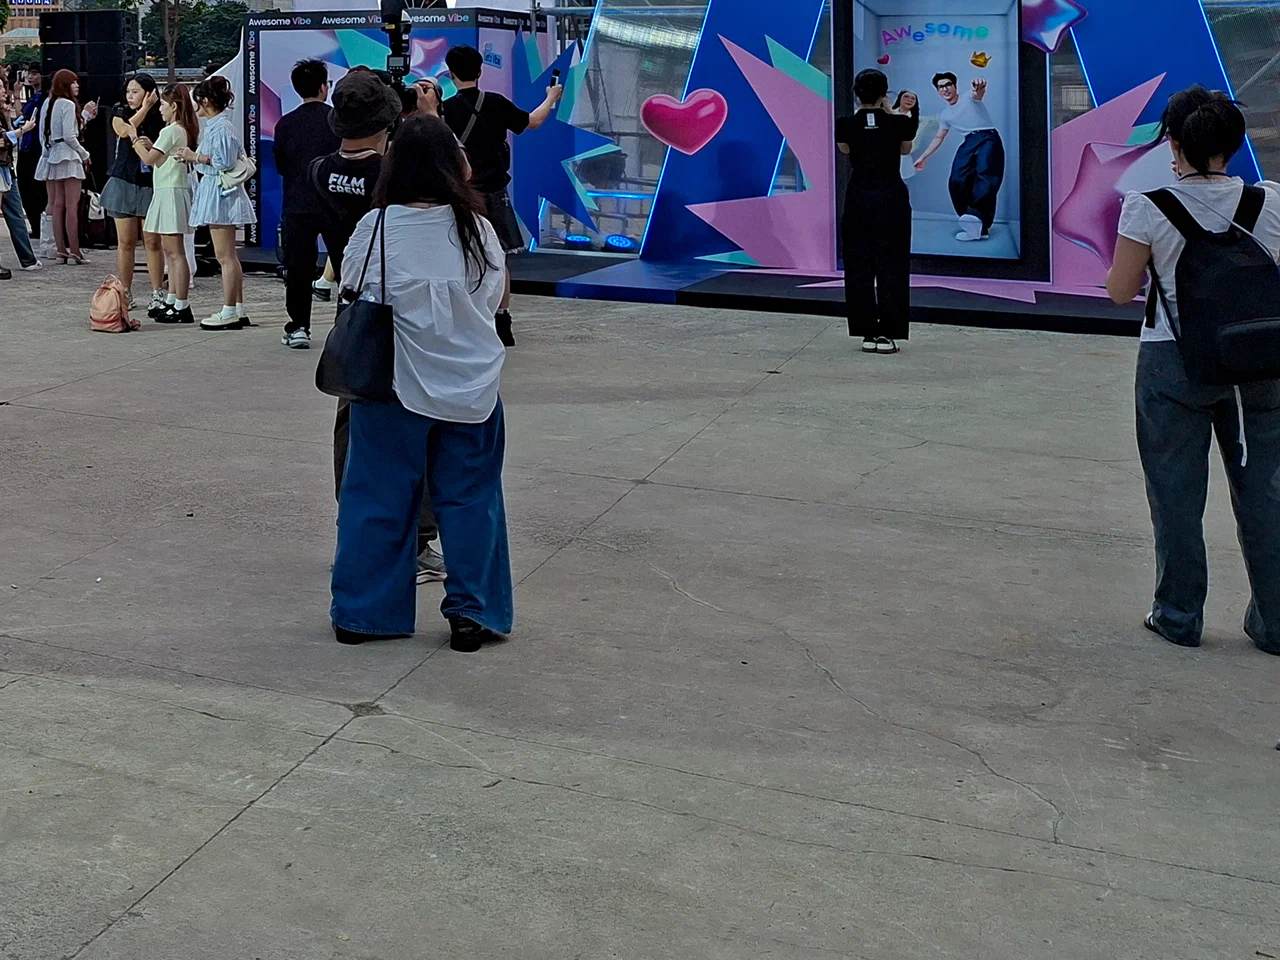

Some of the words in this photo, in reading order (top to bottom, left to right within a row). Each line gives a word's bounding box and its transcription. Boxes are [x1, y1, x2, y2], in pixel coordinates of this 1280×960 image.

[248, 18, 291, 26] Awesome
[292, 16, 312, 25] Vibe
[322, 16, 366, 25] Awesome
[368, 14, 382, 24] Vib
[410, 14, 446, 23] wesome
[448, 13, 470, 22] Vibe
[248, 30, 256, 50] Vibe
[881, 22, 990, 46] Awesome
[248, 50, 256, 94] Awesome
[248, 104, 256, 124] Vibe
[249, 178, 257, 198] Vibe
[328, 172, 365, 189] FILM
[328, 184, 366, 196] CREW
